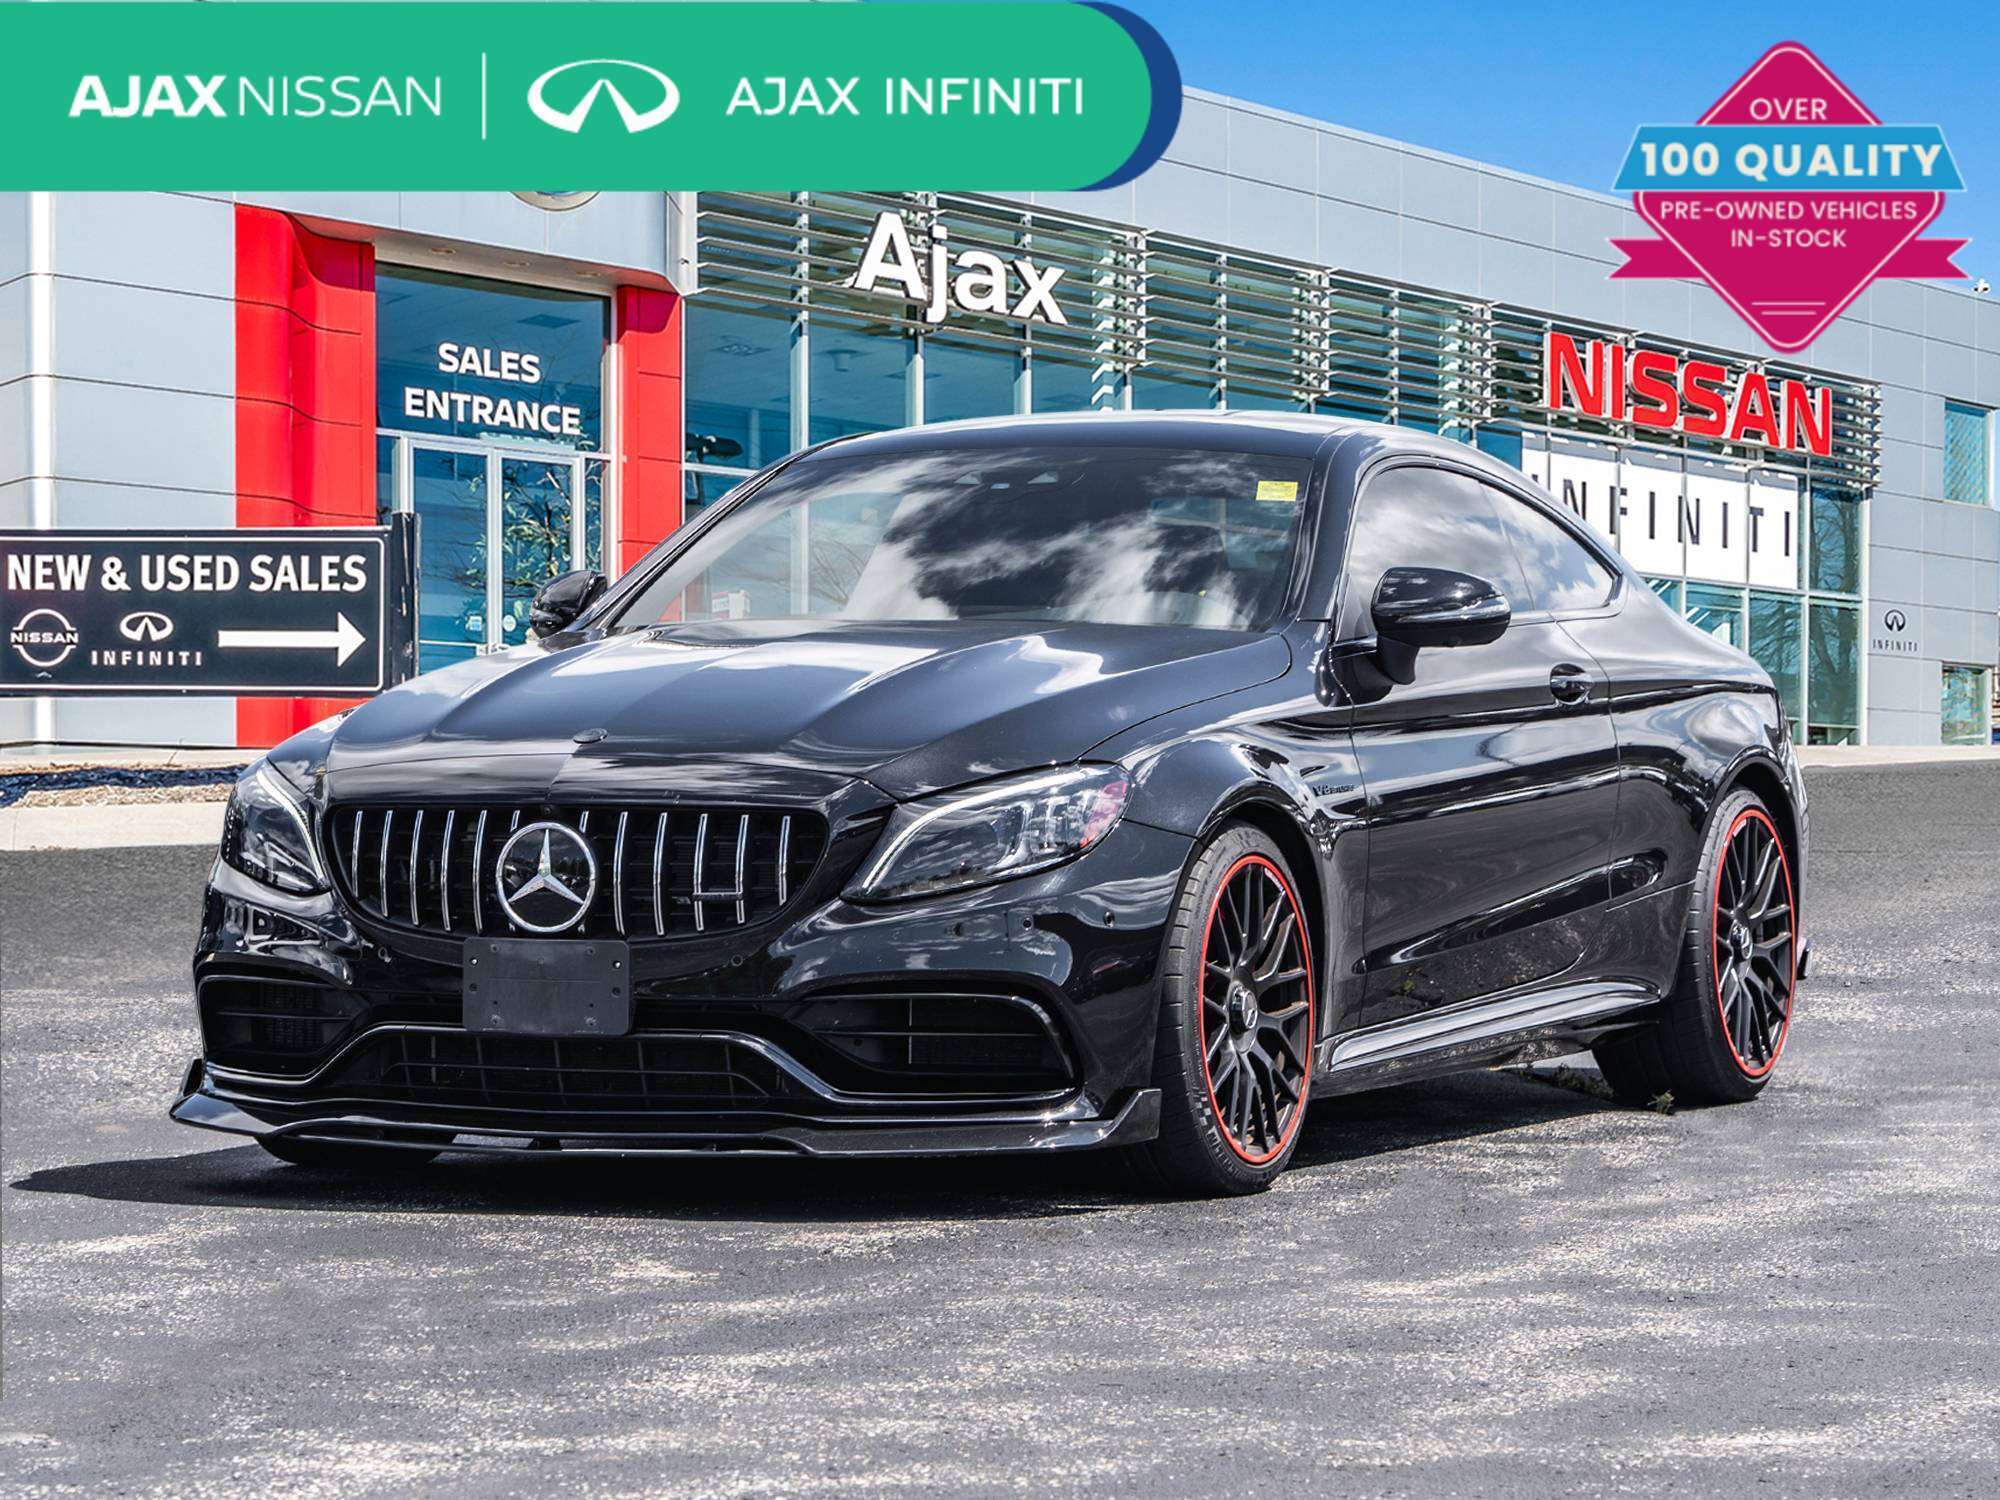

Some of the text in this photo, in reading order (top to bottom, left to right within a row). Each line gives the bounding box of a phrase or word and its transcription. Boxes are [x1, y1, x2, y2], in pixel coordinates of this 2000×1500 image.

[853, 210, 1068, 325] Ajax
[438, 342, 541, 384] SALES
[404, 386, 581, 436] ENTRANCE
[1544, 331, 1833, 457] NISSAN
[7, 553, 368, 593] NEW & USED SALES
[10, 631, 80, 644] NISSAN
[91, 650, 202, 666] INFINITI
[1872, 639, 1919, 652] INFINITI
